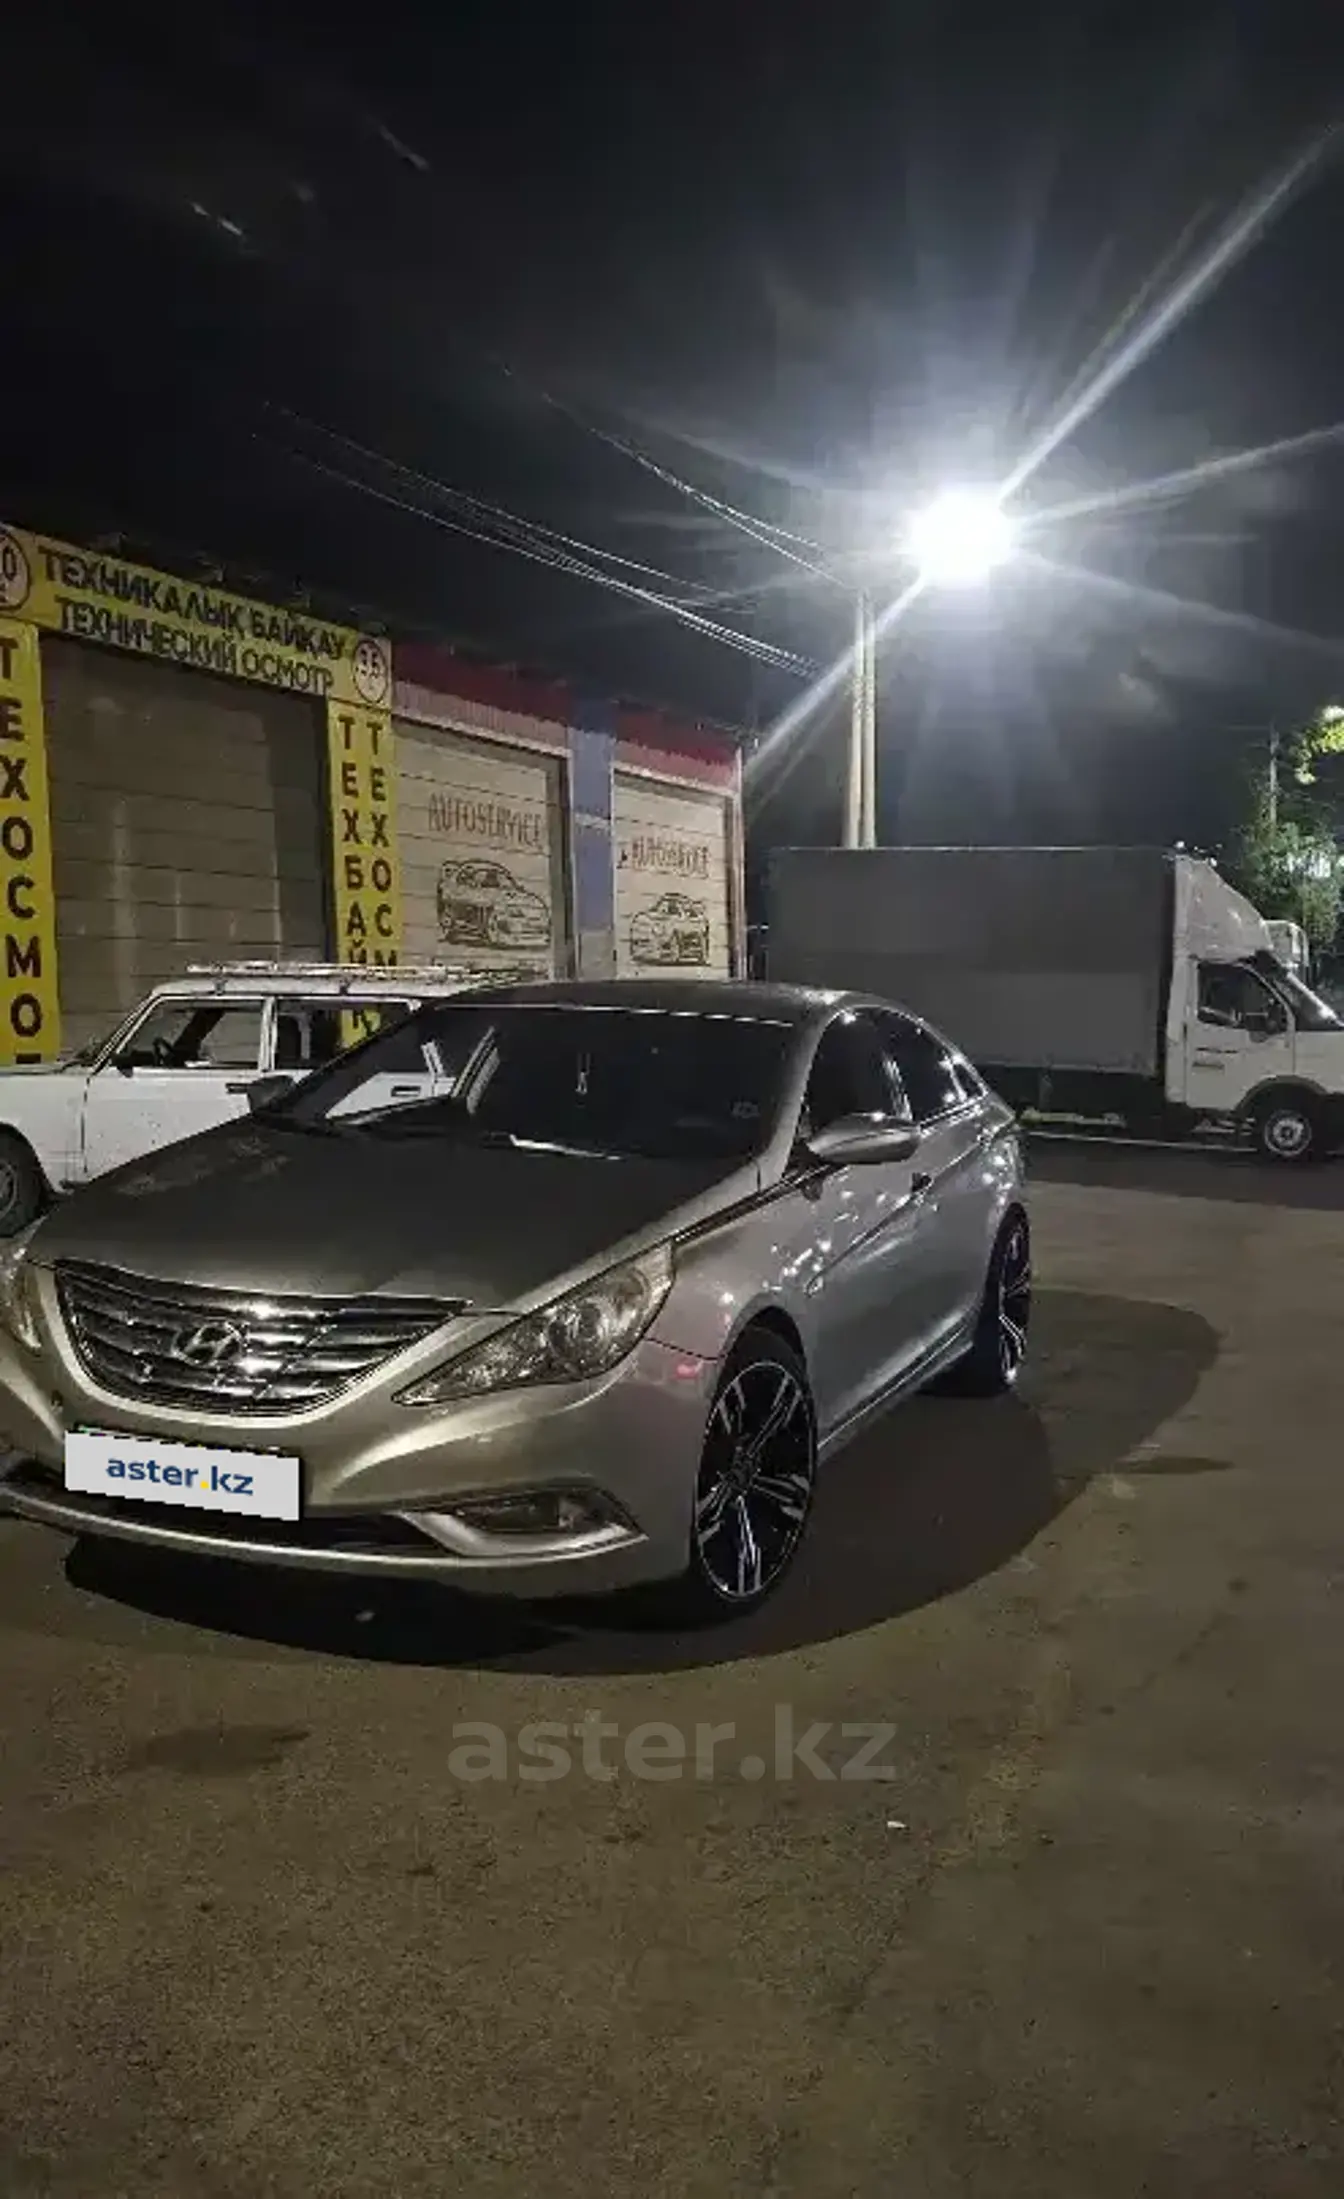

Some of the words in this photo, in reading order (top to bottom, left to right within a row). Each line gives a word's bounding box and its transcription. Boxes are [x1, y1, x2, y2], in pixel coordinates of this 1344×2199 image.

[54, 594, 237, 674] ТЕХНИЧЕСКИЙ
[242, 648, 334, 697] ОСМОТР
[0, 637, 42, 1064] ТЕХОСМО
